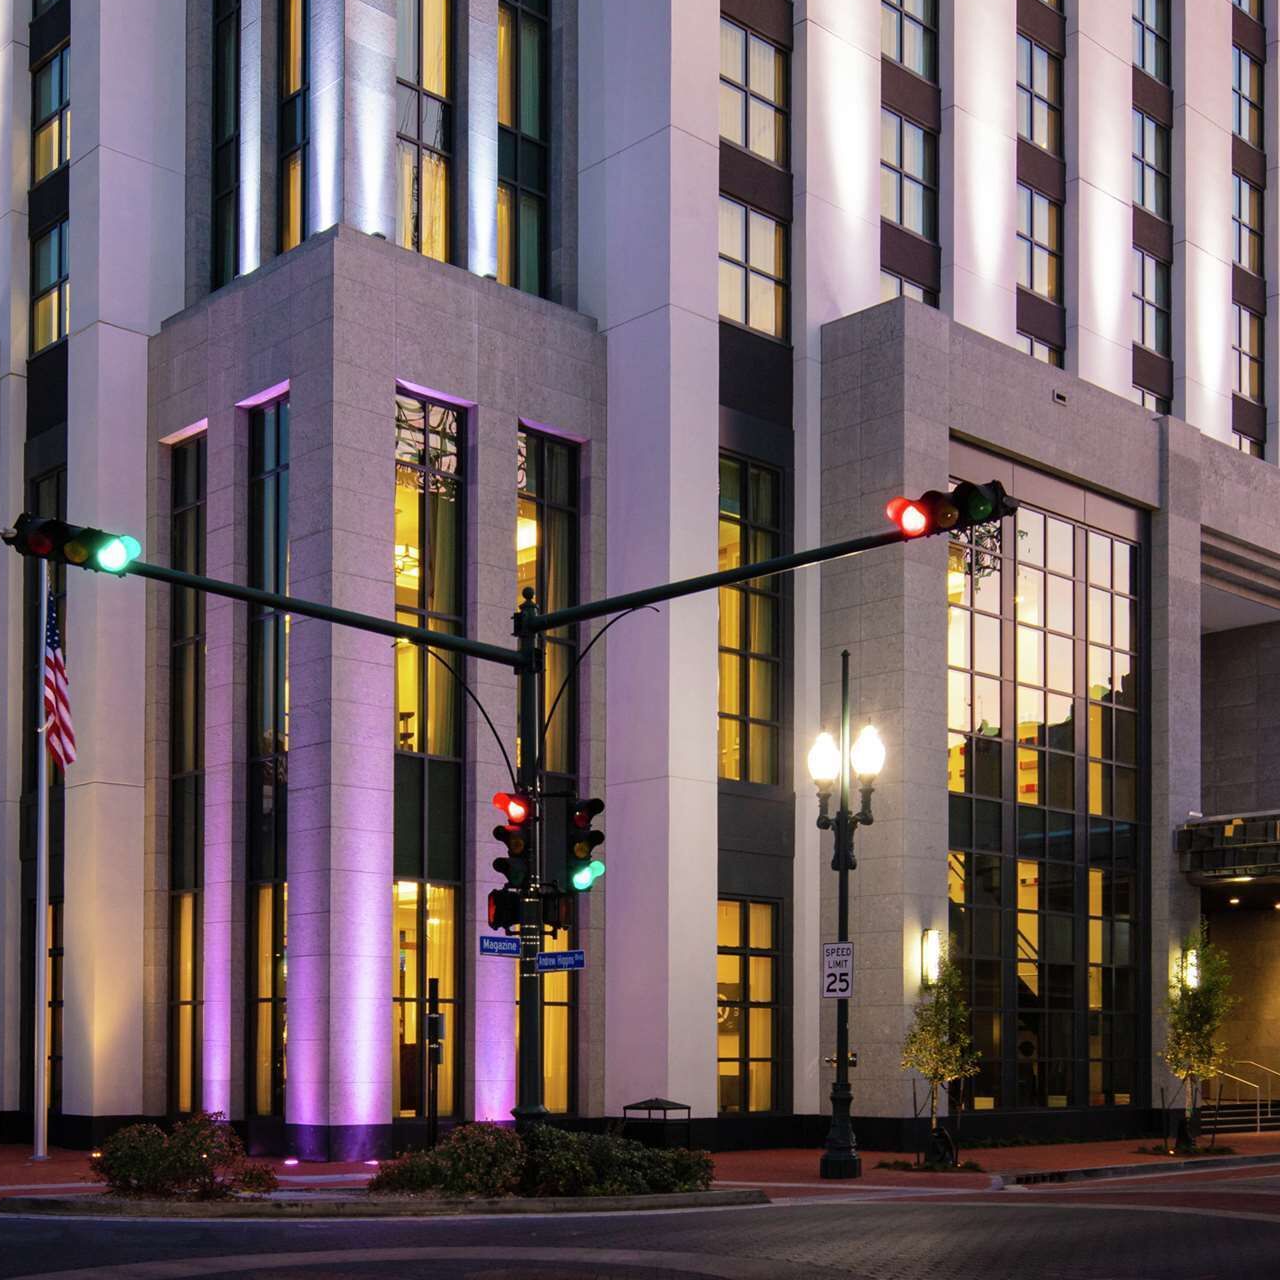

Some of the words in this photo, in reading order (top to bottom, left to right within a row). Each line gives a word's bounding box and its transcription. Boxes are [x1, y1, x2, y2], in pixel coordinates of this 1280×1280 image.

[483, 939, 517, 952] Magazine
[825, 947, 852, 957] SPEED
[828, 959, 849, 969] LIMIT
[826, 972, 850, 993] 25
